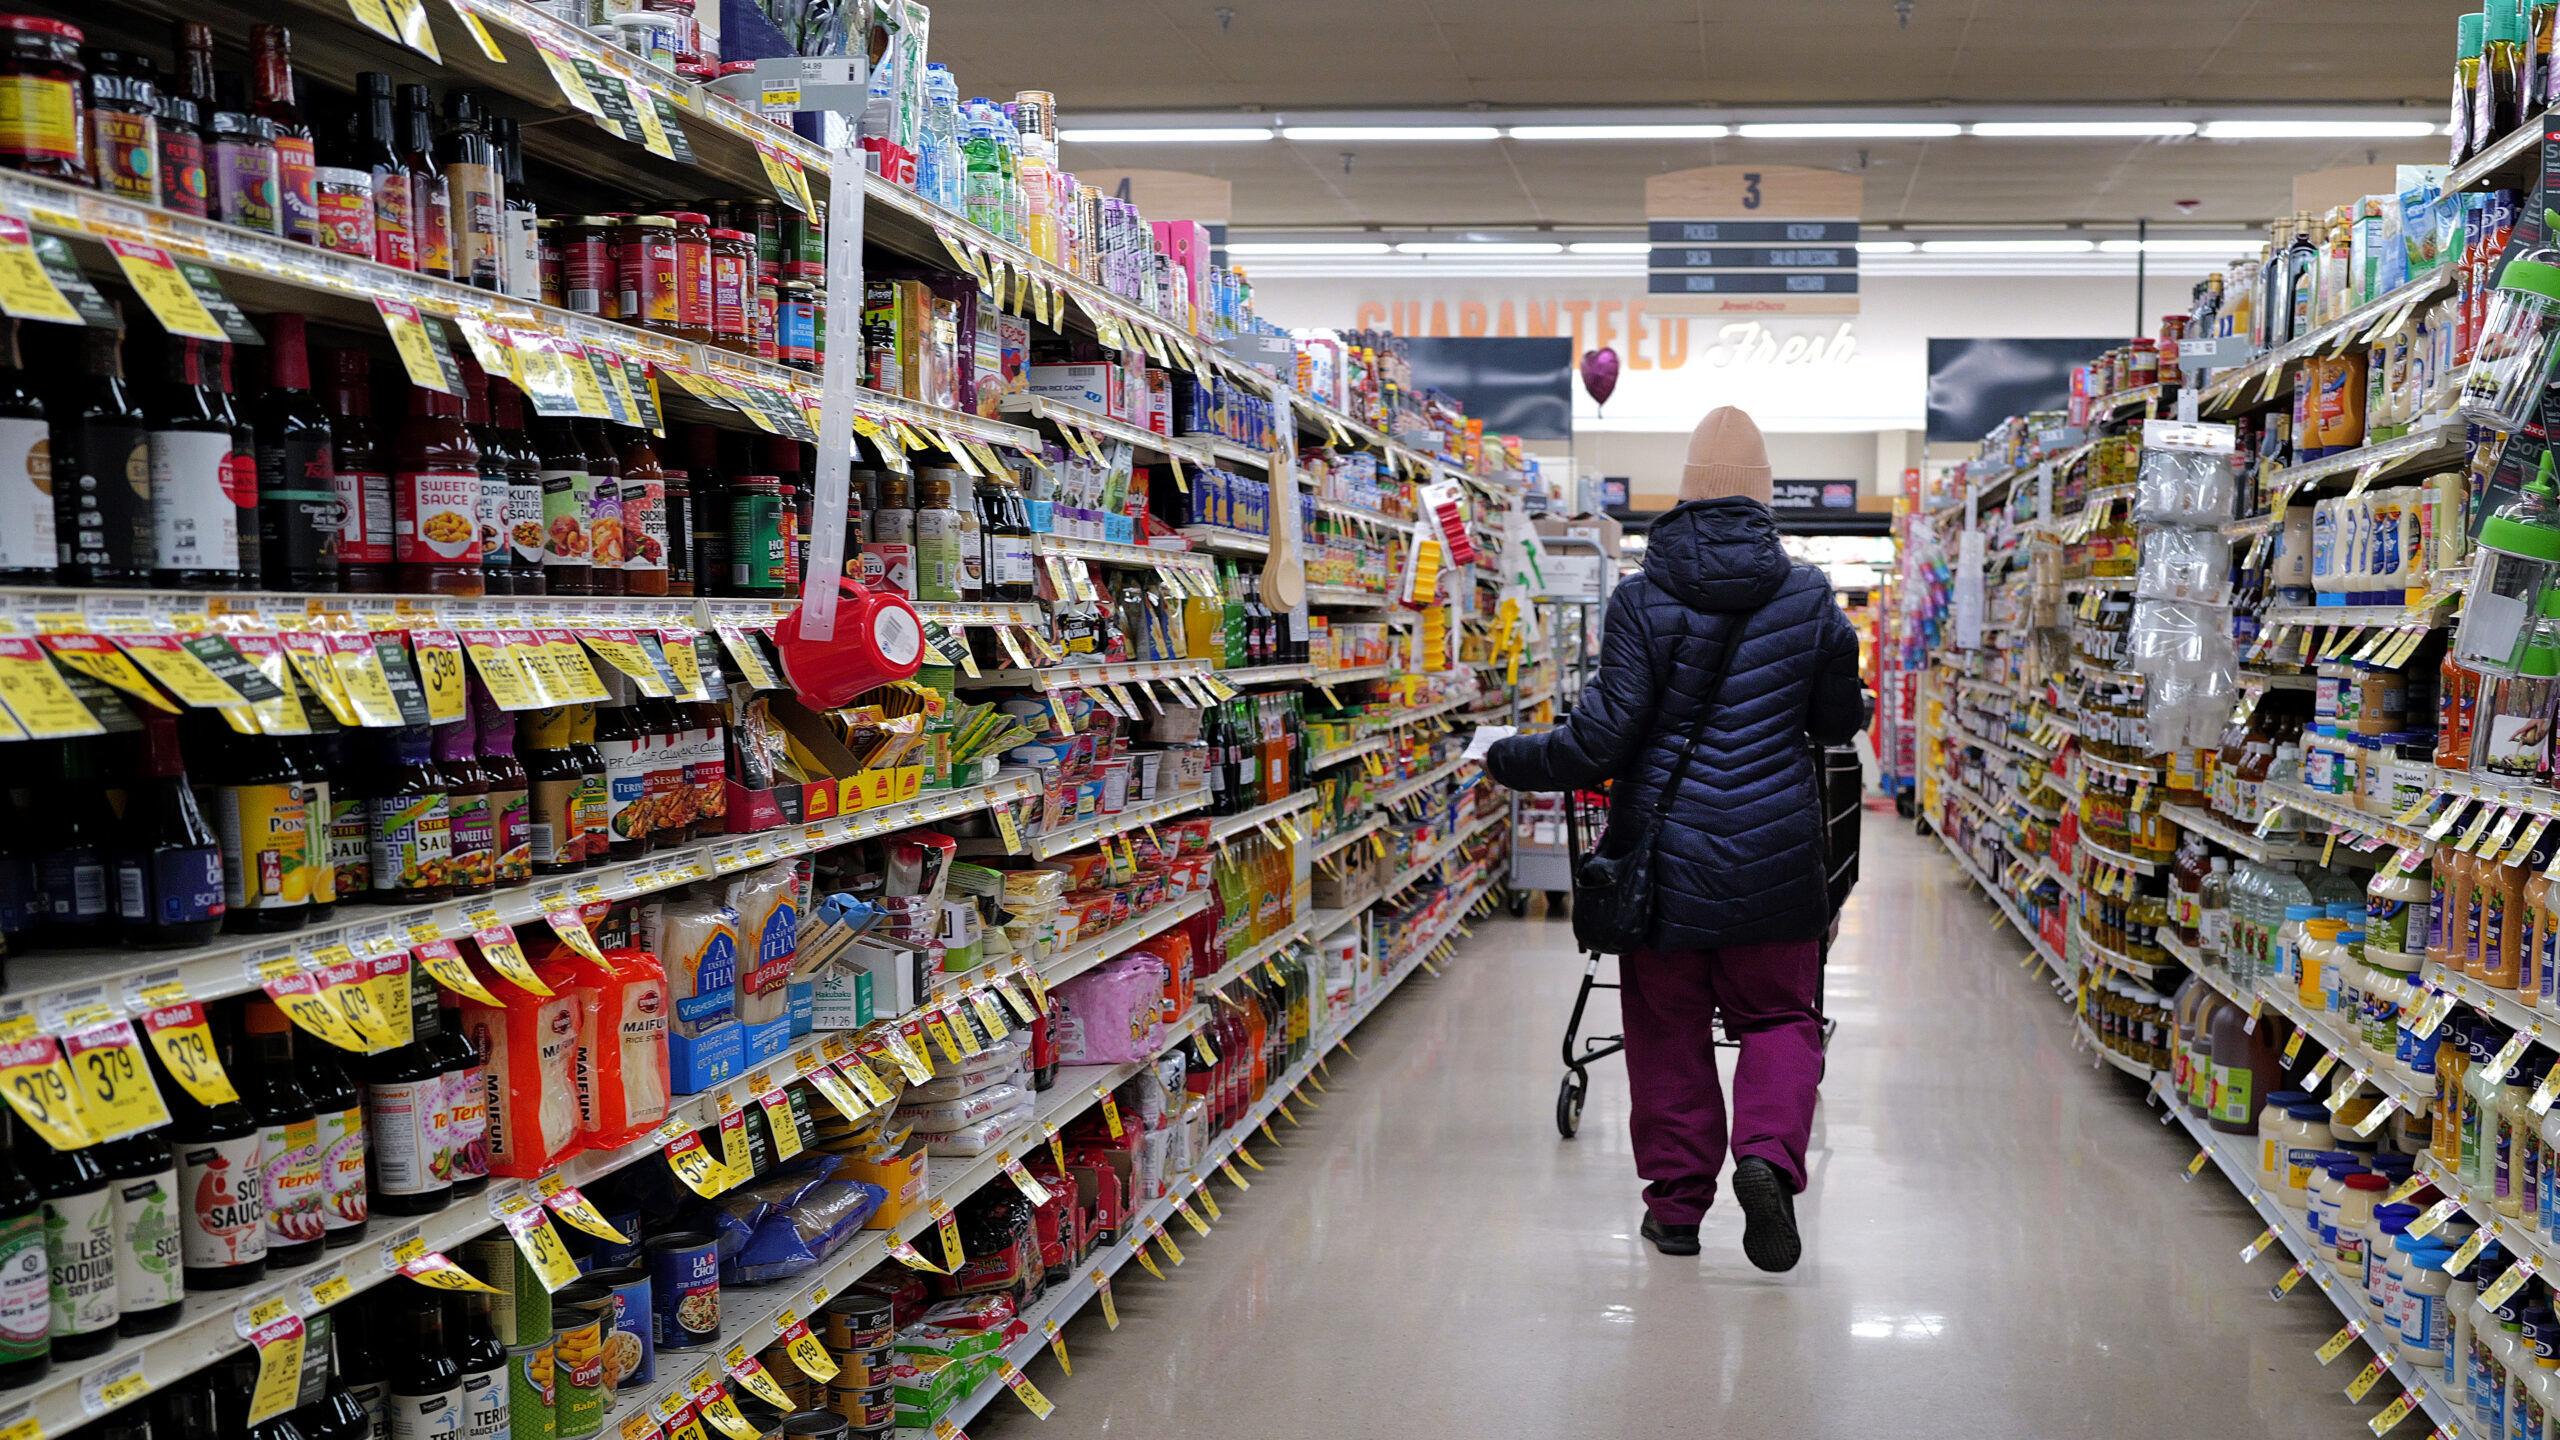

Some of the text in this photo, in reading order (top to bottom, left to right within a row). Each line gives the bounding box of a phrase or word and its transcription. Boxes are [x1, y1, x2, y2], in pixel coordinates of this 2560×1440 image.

[1743, 173, 1761, 210] 3
[1770, 250, 1839, 265] SALAD DRESSING
[1718, 300, 1786, 311] Jewel-Osco
[1706, 320, 1858, 368] Fresh
[421, 481, 466, 492] SWEET
[421, 494, 468, 505] SAUCE
[509, 501, 527, 509] STIR
[427, 651, 457, 692] 398
[480, 659, 515, 678] FREE
[518, 657, 554, 675] FREE
[555, 653, 589, 673] FREE
[777, 911, 789, 931] A
[421, 943, 451, 958] Sale!
[715, 940, 728, 960] A
[327, 965, 358, 984] Sale!
[374, 959, 402, 974] Sale!
[274, 977, 309, 995] Sale!
[815, 990, 851, 999] Hakubaku
[155, 1006, 193, 1028] Sale!
[823, 1015, 850, 1028] 7.1.26
[625, 1035, 644, 1044] RICE
[0, 1043, 45, 1067] Sale!
[168, 1033, 208, 1083] 379
[88, 1047, 135, 1102] 379
[577, 1047, 592, 1121] MAIFUN
[14, 1068, 67, 1124] 379
[487, 1075, 504, 1154] MAIFUN
[671, 1135, 694, 1153] Sale!
[677, 1150, 708, 1184] 579
[211, 1200, 263, 1229] SAUCE
[80, 1235, 112, 1261] LESS
[524, 1226, 555, 1266] 379
[693, 1257, 706, 1268] LA
[693, 1265, 715, 1278] CHOY
[786, 1325, 804, 1342] Sale!
[797, 1339, 819, 1371] 199
[736, 1361, 754, 1378] Sale!
[699, 1387, 720, 1406] Sale!
[752, 1374, 773, 1402] 199
[572, 1399, 597, 1413] Baby
[670, 1410, 691, 1430] Sale!
[709, 1400, 735, 1432] 199
[470, 1425, 494, 1437] SAUCE
